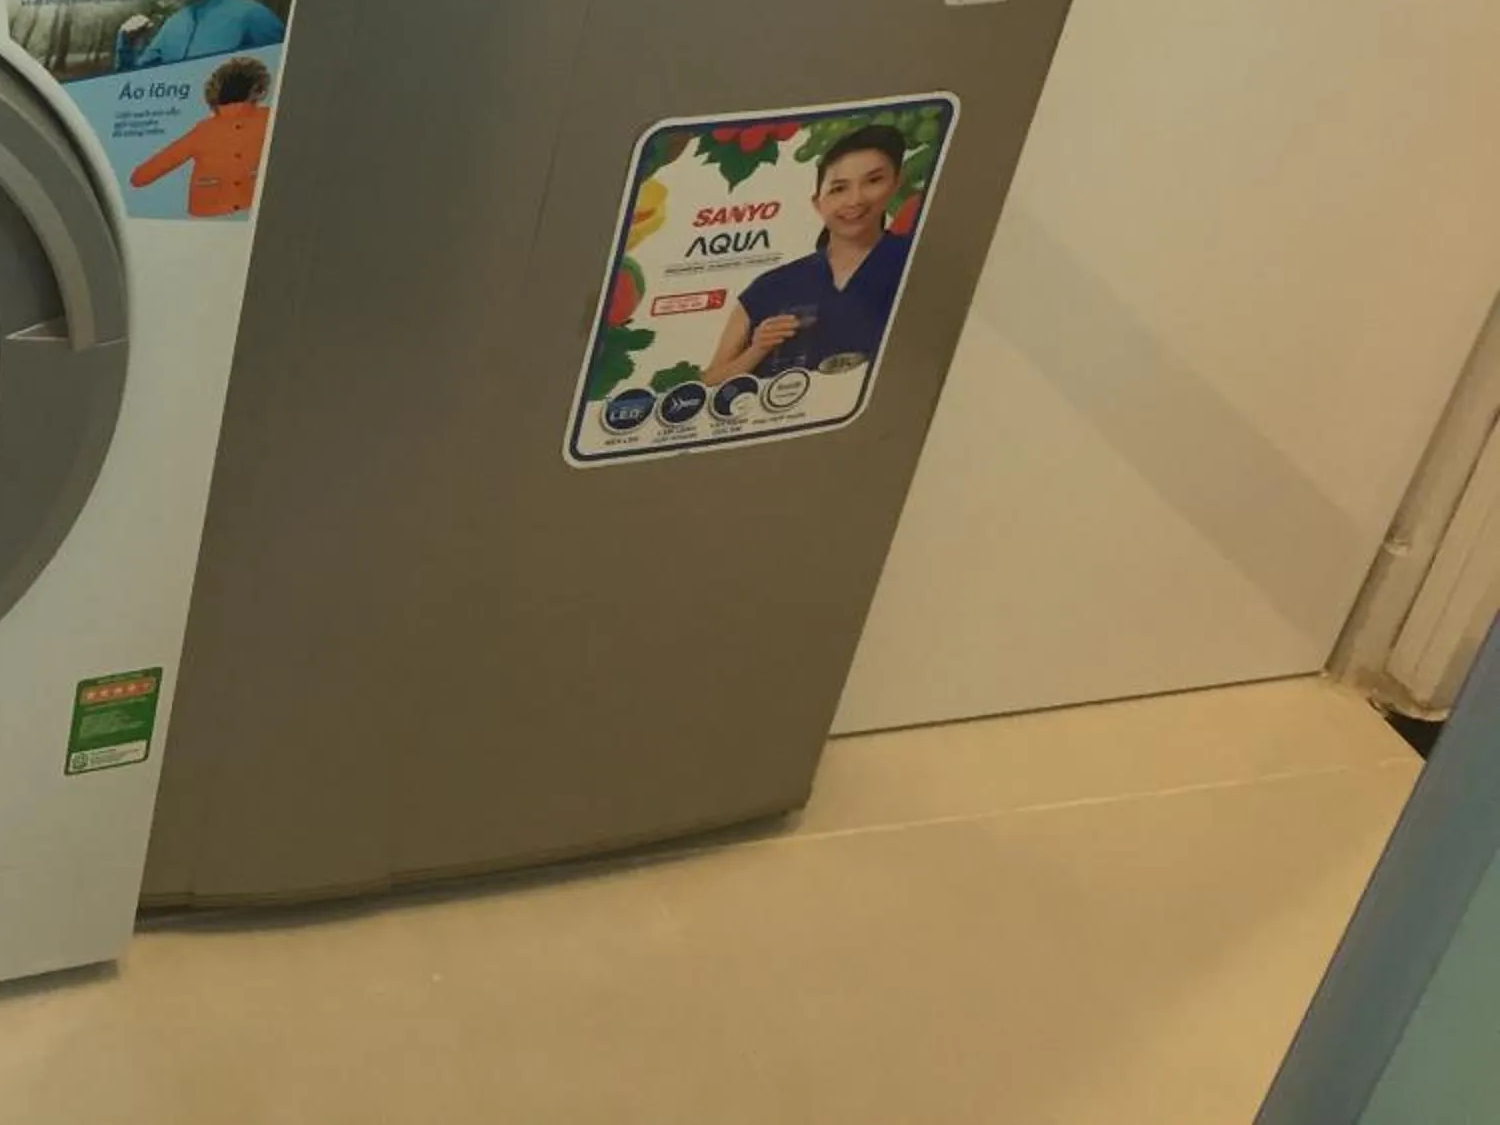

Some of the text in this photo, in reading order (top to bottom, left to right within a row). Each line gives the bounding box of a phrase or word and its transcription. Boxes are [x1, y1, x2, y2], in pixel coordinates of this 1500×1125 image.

[118, 80, 192, 101] Áo lông
[691, 200, 781, 228] SANYO
[684, 228, 770, 258] AQUA
